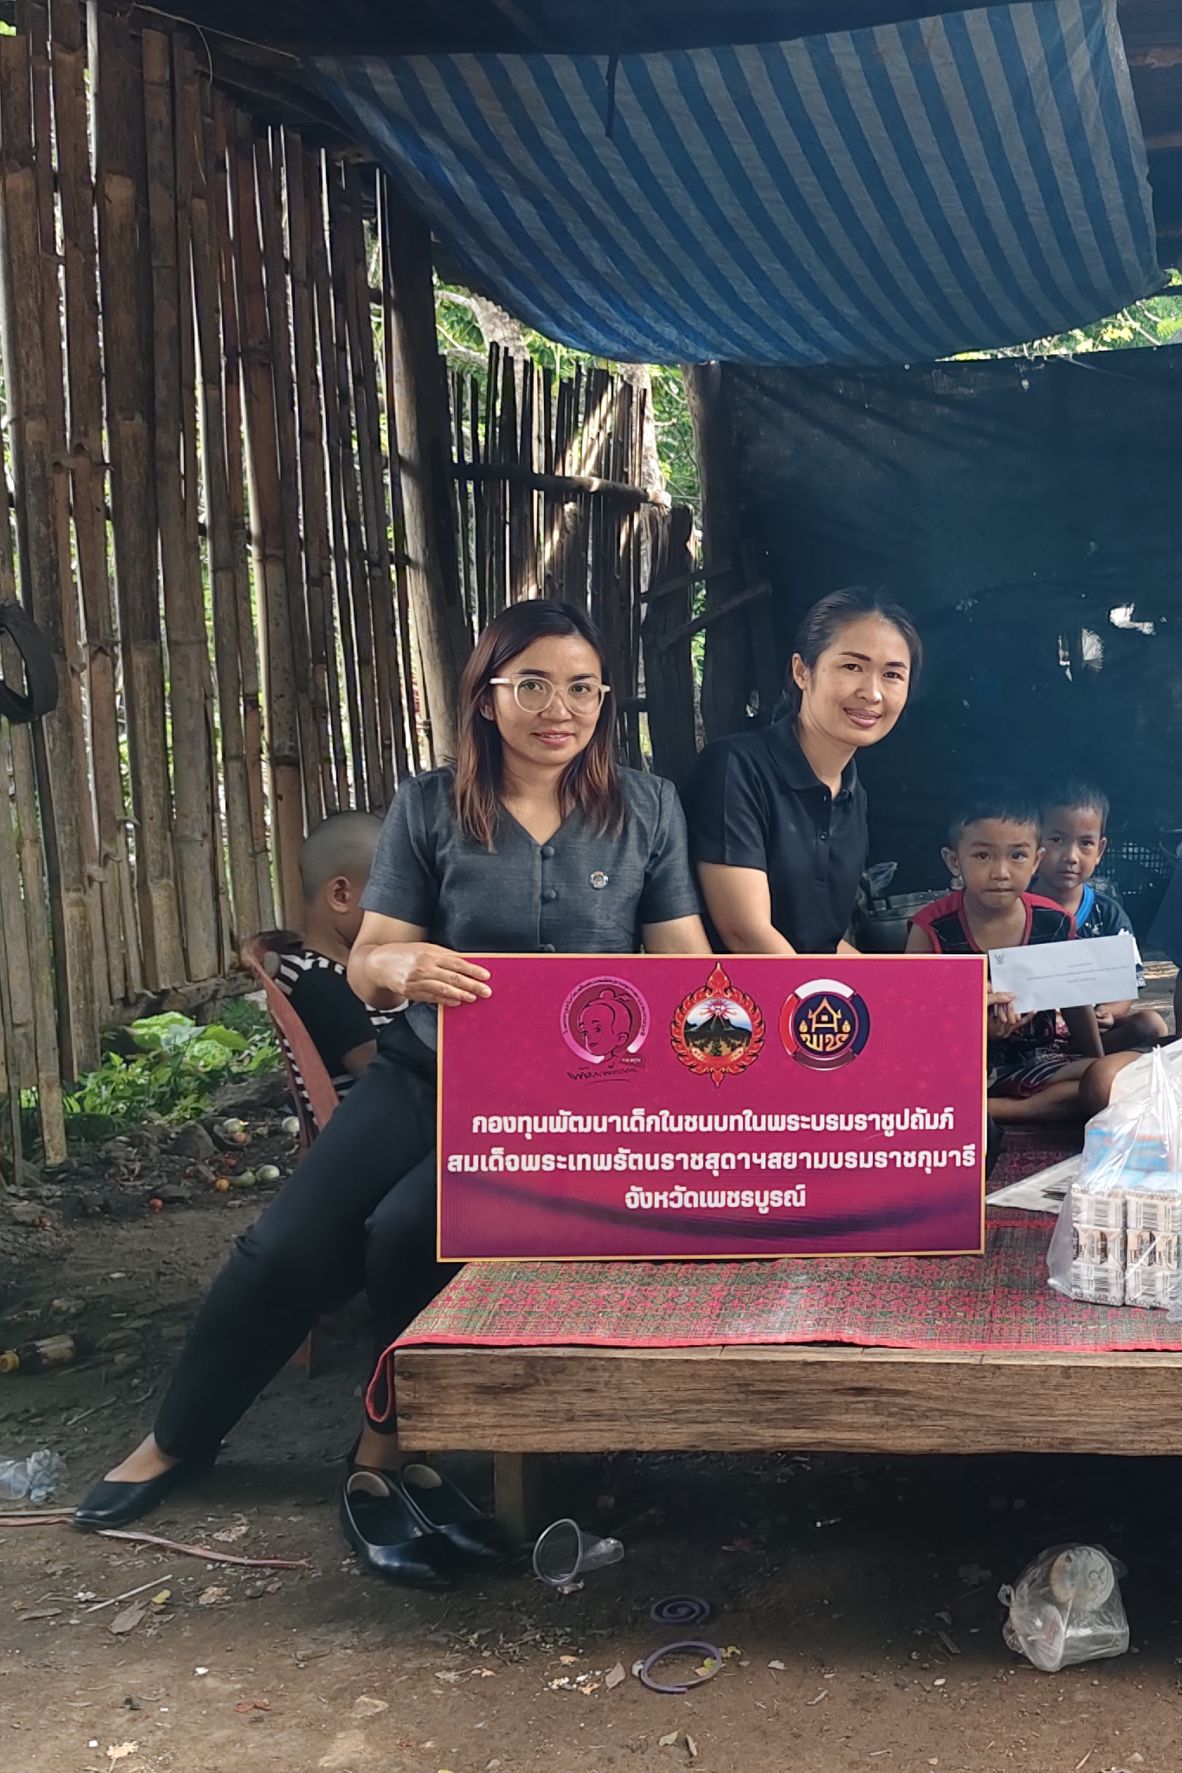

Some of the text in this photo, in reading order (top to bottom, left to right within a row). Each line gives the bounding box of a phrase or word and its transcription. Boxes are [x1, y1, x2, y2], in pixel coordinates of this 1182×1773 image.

[471, 1107, 955, 1140] กองทุนพัฒนาเด็กในชนบทในพระบรมราชูปถัมภ์
[446, 1144, 977, 1177] สมเด็จพระเทพรัตนราชสุดาฯสยามบรมราชกุมารี
[624, 1184, 807, 1214] จังหวัดเพชรบูรณ์
